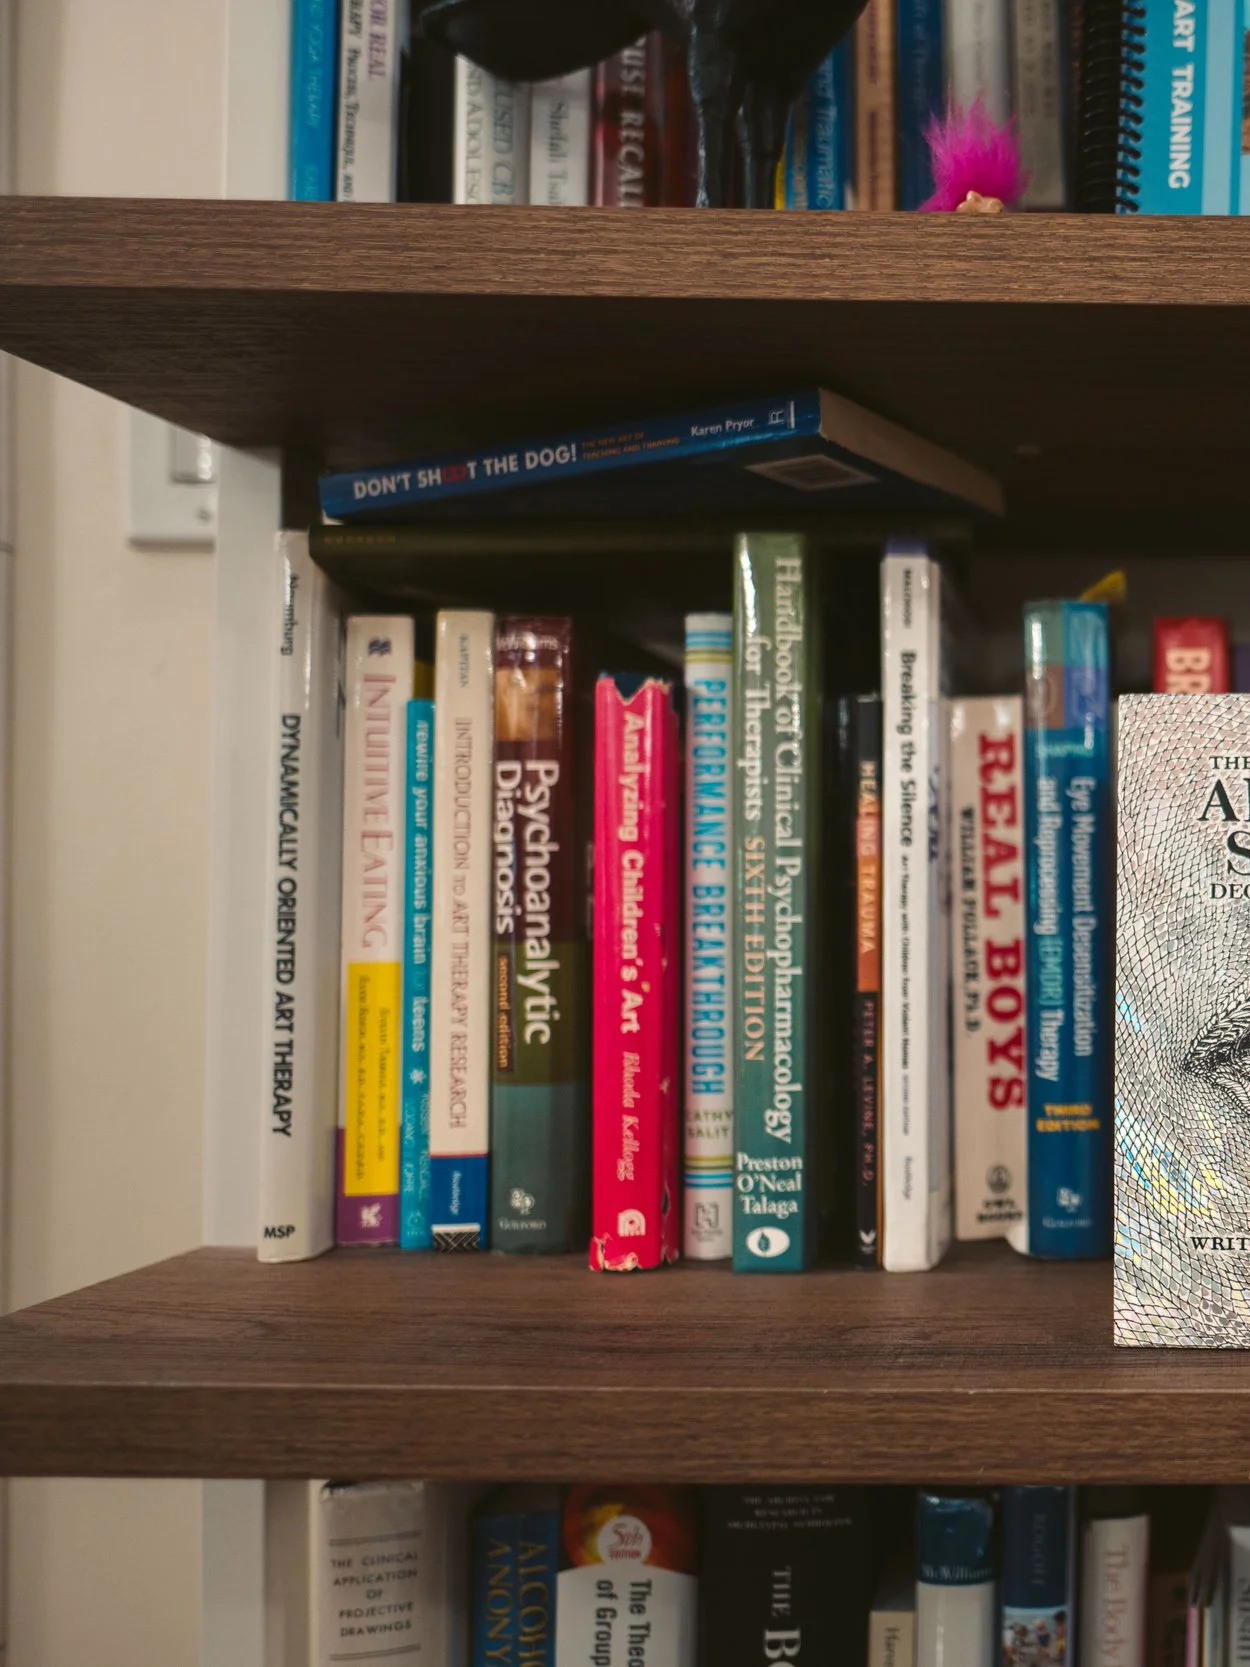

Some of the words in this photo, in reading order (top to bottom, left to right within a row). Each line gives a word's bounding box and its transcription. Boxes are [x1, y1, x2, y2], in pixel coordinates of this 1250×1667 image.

[1174, 0, 1195, 52] ART
[617, 110, 645, 205] RECAL
[1169, 62, 1194, 190] TRAINING
[690, 420, 724, 440] Karen
[353, 472, 412, 500] DON'T
[482, 454, 520, 478] THE
[525, 443, 578, 471] DOG!
[744, 634, 772, 676] for
[775, 556, 803, 702] Handbook
[775, 705, 802, 737] of
[895, 650, 918, 736] Breaking
[363, 673, 398, 825] INTUITIVE
[617, 711, 646, 842] Analyzing
[692, 677, 727, 872] PERFORMANCE
[736, 682, 771, 822] Therapists
[900, 741, 918, 773] the
[278, 713, 302, 870] DYNAMICALLY
[411, 786, 430, 829] your
[452, 717, 474, 870] INTRODUCTION
[774, 741, 802, 848] Clinical
[859, 760, 877, 857] HEALING
[900, 779, 918, 847] Silence
[979, 731, 1021, 919] REAL
[1037, 777, 1062, 813] and
[1066, 775, 1097, 811] Eye
[413, 832, 430, 910] anxious
[494, 759, 522, 935] Diagnosis
[743, 835, 766, 924] SIXTH
[960, 806, 977, 892] WILLIAM
[1034, 815, 1063, 935] Reprocessing
[1070, 814, 1096, 912] Movement
[360, 830, 396, 949] EATING
[451, 901, 471, 935] ART
[516, 759, 561, 1046] Psychoanalytic
[620, 849, 645, 982] Children's
[859, 865, 877, 954] TRAUMA
[276, 878, 298, 985] ORIENTED
[411, 912, 430, 965] brain
[274, 991, 295, 1033] ART
[450, 942, 470, 1027] THERAPY
[498, 955, 513, 1010] second
[620, 988, 644, 1034] Art
[690, 884, 727, 1095] BREAKTHROUGH
[743, 933, 766, 1062] EDITION
[765, 855, 803, 1145] Psychopharmacology
[1073, 915, 1097, 1056] Desensitization
[410, 995, 428, 1053] teens
[498, 1014, 513, 1069] edition
[984, 938, 1027, 1111] BOYS
[1034, 1008, 1065, 1082] Therapy
[272, 1040, 295, 1138] THERAPY
[449, 1031, 469, 1129] RESEARCH
[616, 1114, 640, 1182] Kellogg
[736, 1151, 804, 1172] Preston
[736, 1171, 802, 1193] O'Neal
[263, 1225, 296, 1239] MSP
[739, 1194, 800, 1220] Talaga
[333, 1568, 418, 1587] APPLICATION
[361, 1550, 419, 1567] CLINICAL
[365, 1588, 384, 1600] OF
[595, 1579, 618, 1600] of
[770, 1564, 793, 1618] THE
[1103, 1543, 1133, 1592] The
[338, 1600, 415, 1619] PROJECTIVE
[340, 1619, 413, 1638] DRAWINGS
[486, 1537, 513, 1667] ANONY
[628, 1579, 652, 1615] The
[1100, 1598, 1135, 1660] Body
[589, 1606, 618, 1667] Group
